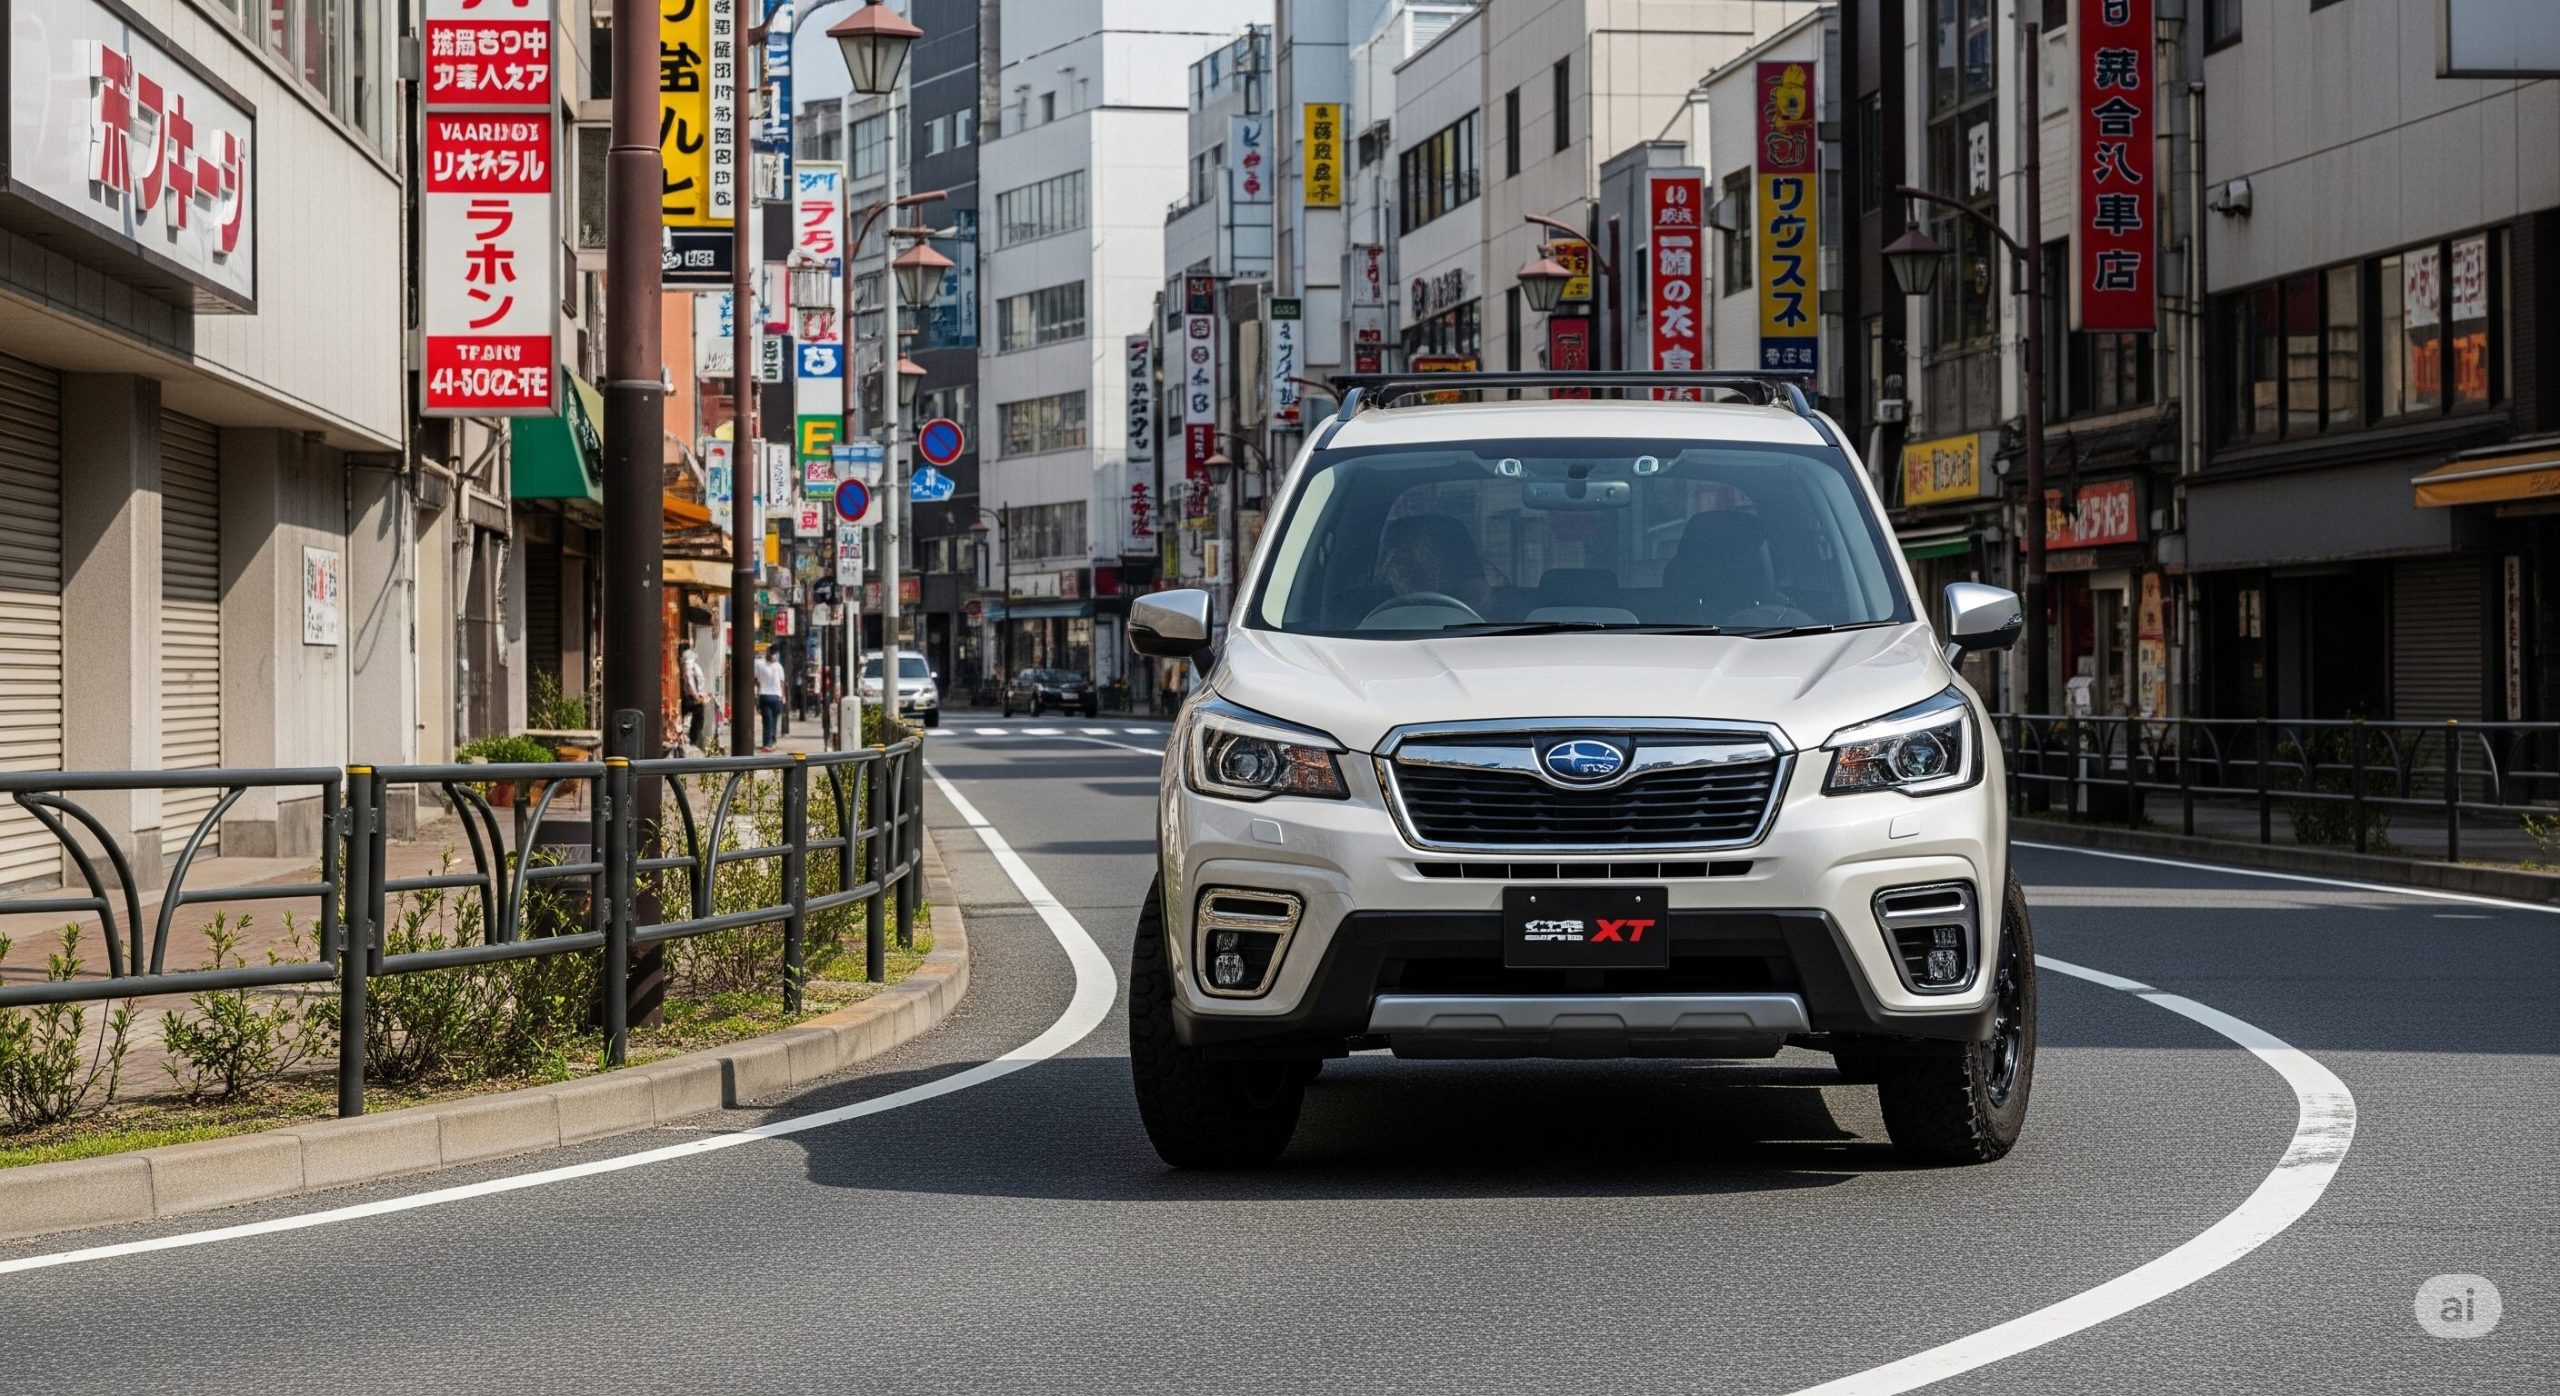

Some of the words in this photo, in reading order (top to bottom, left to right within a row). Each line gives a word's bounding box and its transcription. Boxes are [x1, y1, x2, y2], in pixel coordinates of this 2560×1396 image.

[465, 199, 517, 329] ラホン
[1771, 177, 1807, 328] ワウスネ
[1589, 918, 1657, 943] XT
